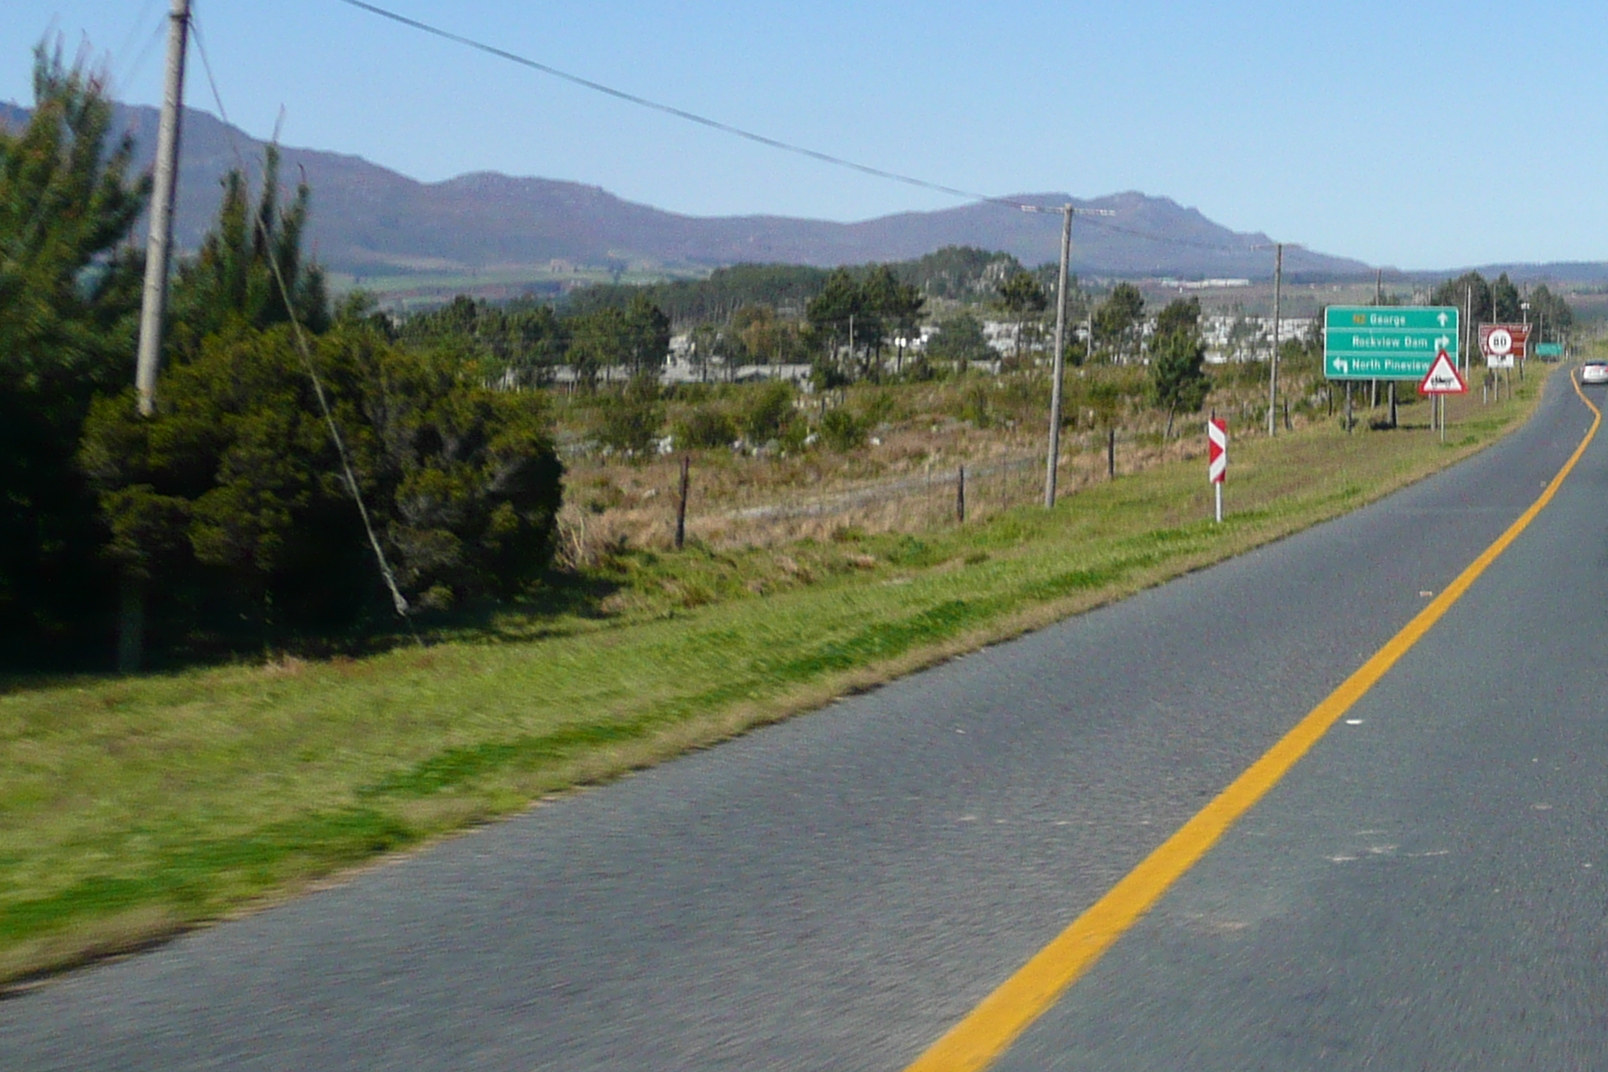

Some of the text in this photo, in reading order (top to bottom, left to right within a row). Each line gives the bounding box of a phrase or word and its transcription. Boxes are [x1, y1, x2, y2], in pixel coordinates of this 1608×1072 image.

[1370, 314, 1405, 327] George
[1352, 335, 1428, 347] Rockview Dam
[1493, 336, 1507, 346] 80
[1352, 358, 1430, 370] North Pineview
